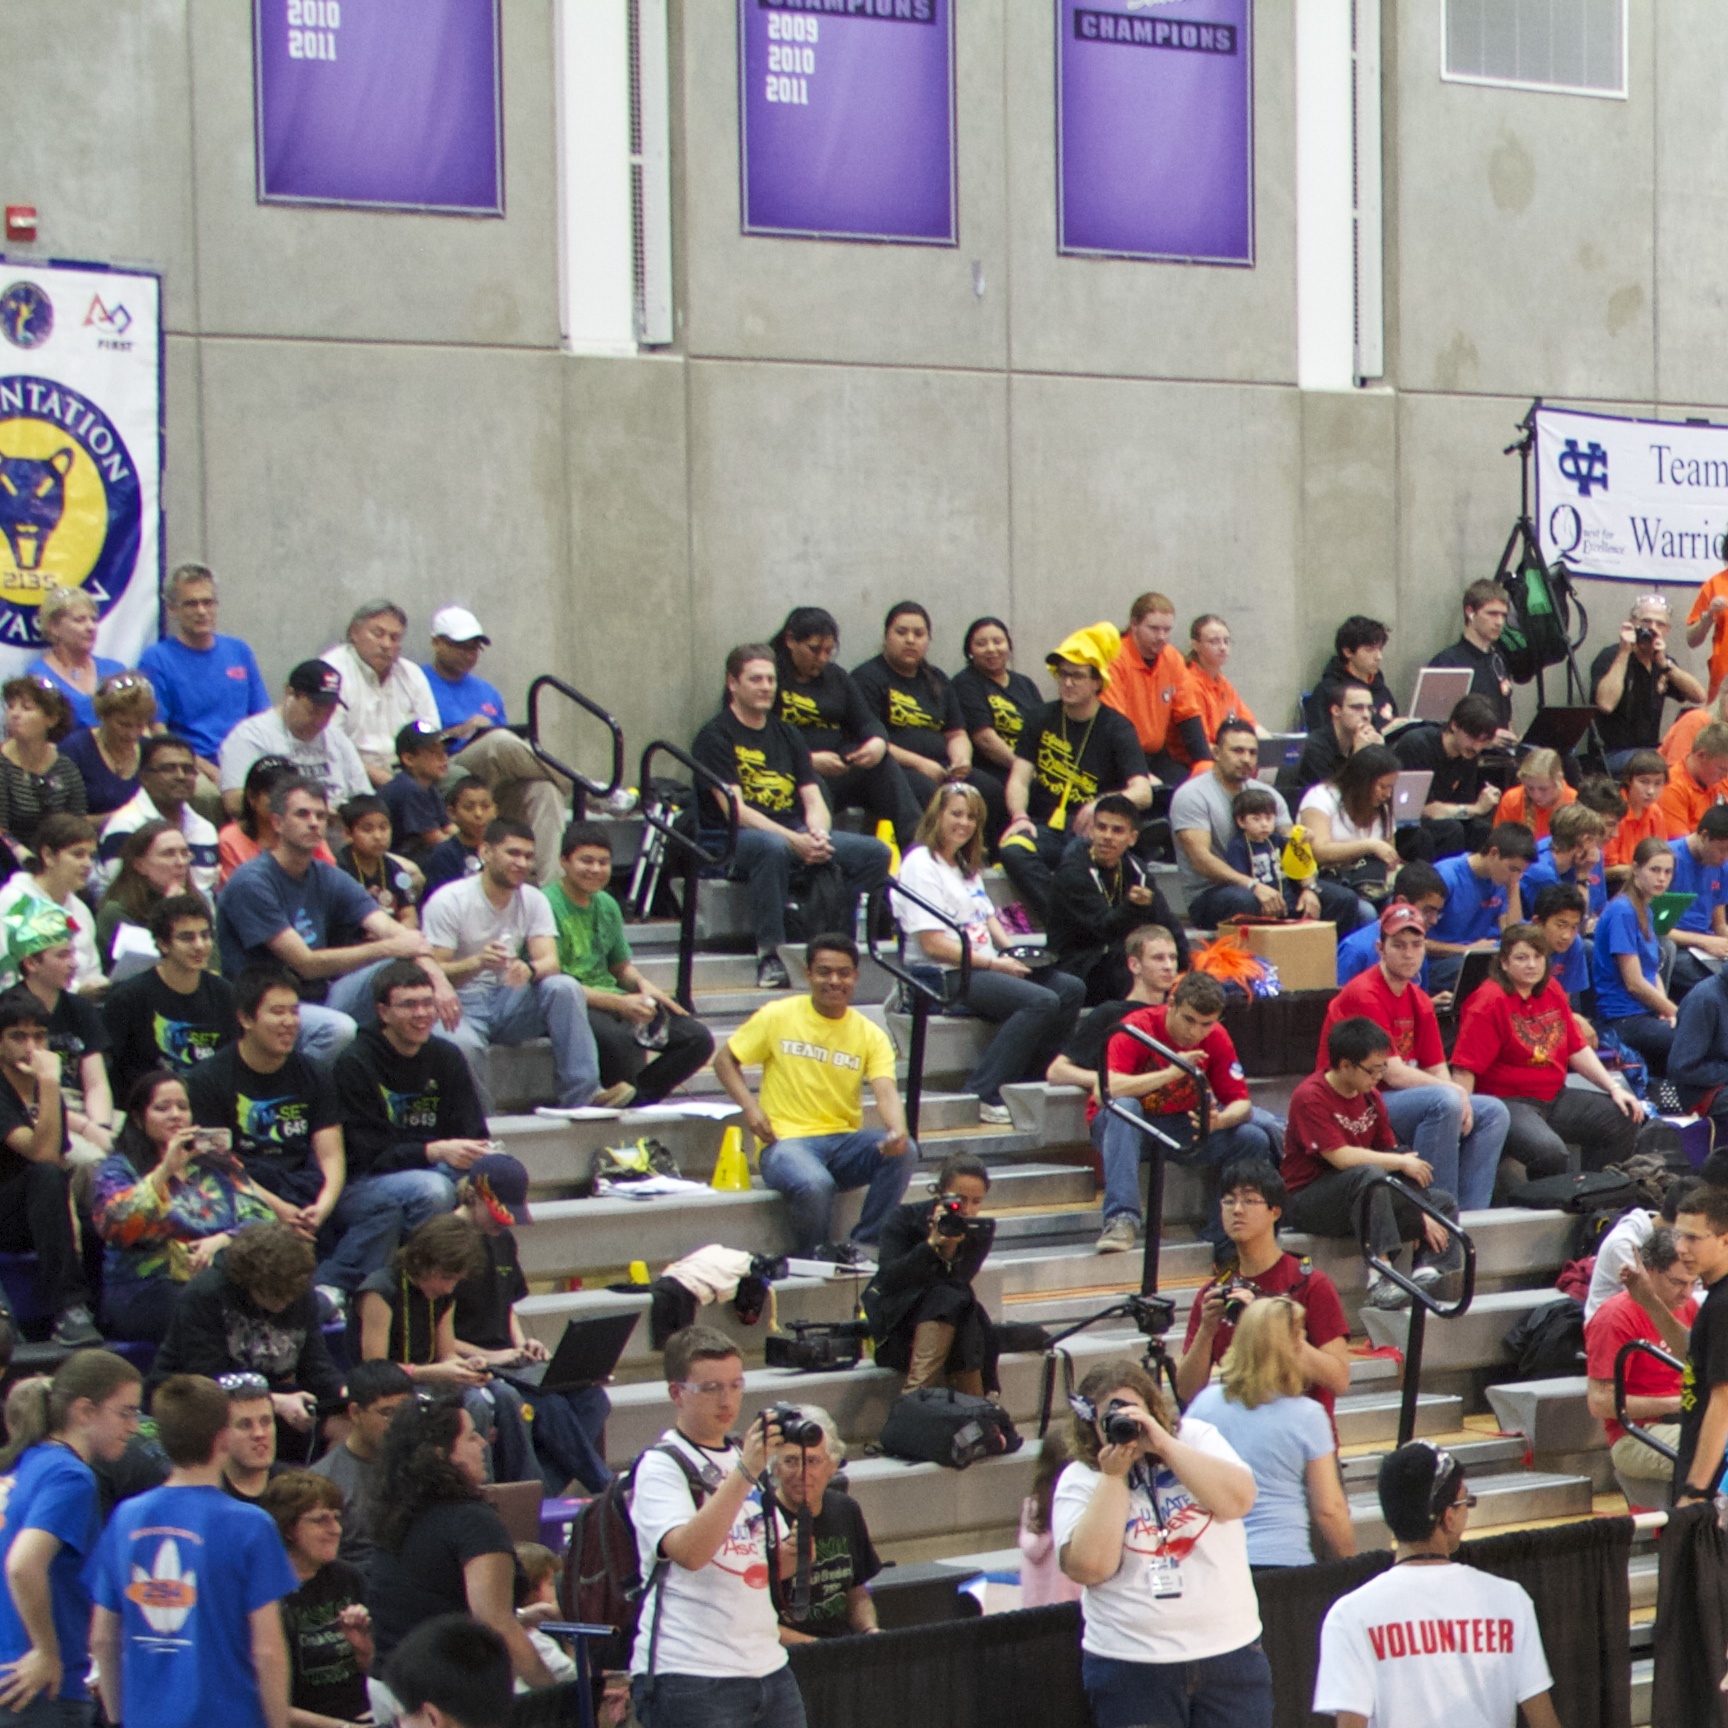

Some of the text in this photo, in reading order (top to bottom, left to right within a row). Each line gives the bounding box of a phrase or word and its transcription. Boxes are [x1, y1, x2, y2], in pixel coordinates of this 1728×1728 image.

[287, 0, 341, 29] 2010
[767, 11, 819, 44] 2009
[288, 30, 337, 61] 2011
[1081, 13, 1231, 51] CHAMPIONS
[768, 44, 815, 75] 2010
[765, 74, 809, 105] 2011
[97, 338, 134, 352] FIRST
[780, 1039, 829, 1063] TEAM
[1368, 1619, 1514, 1661] VOLUNTEER
